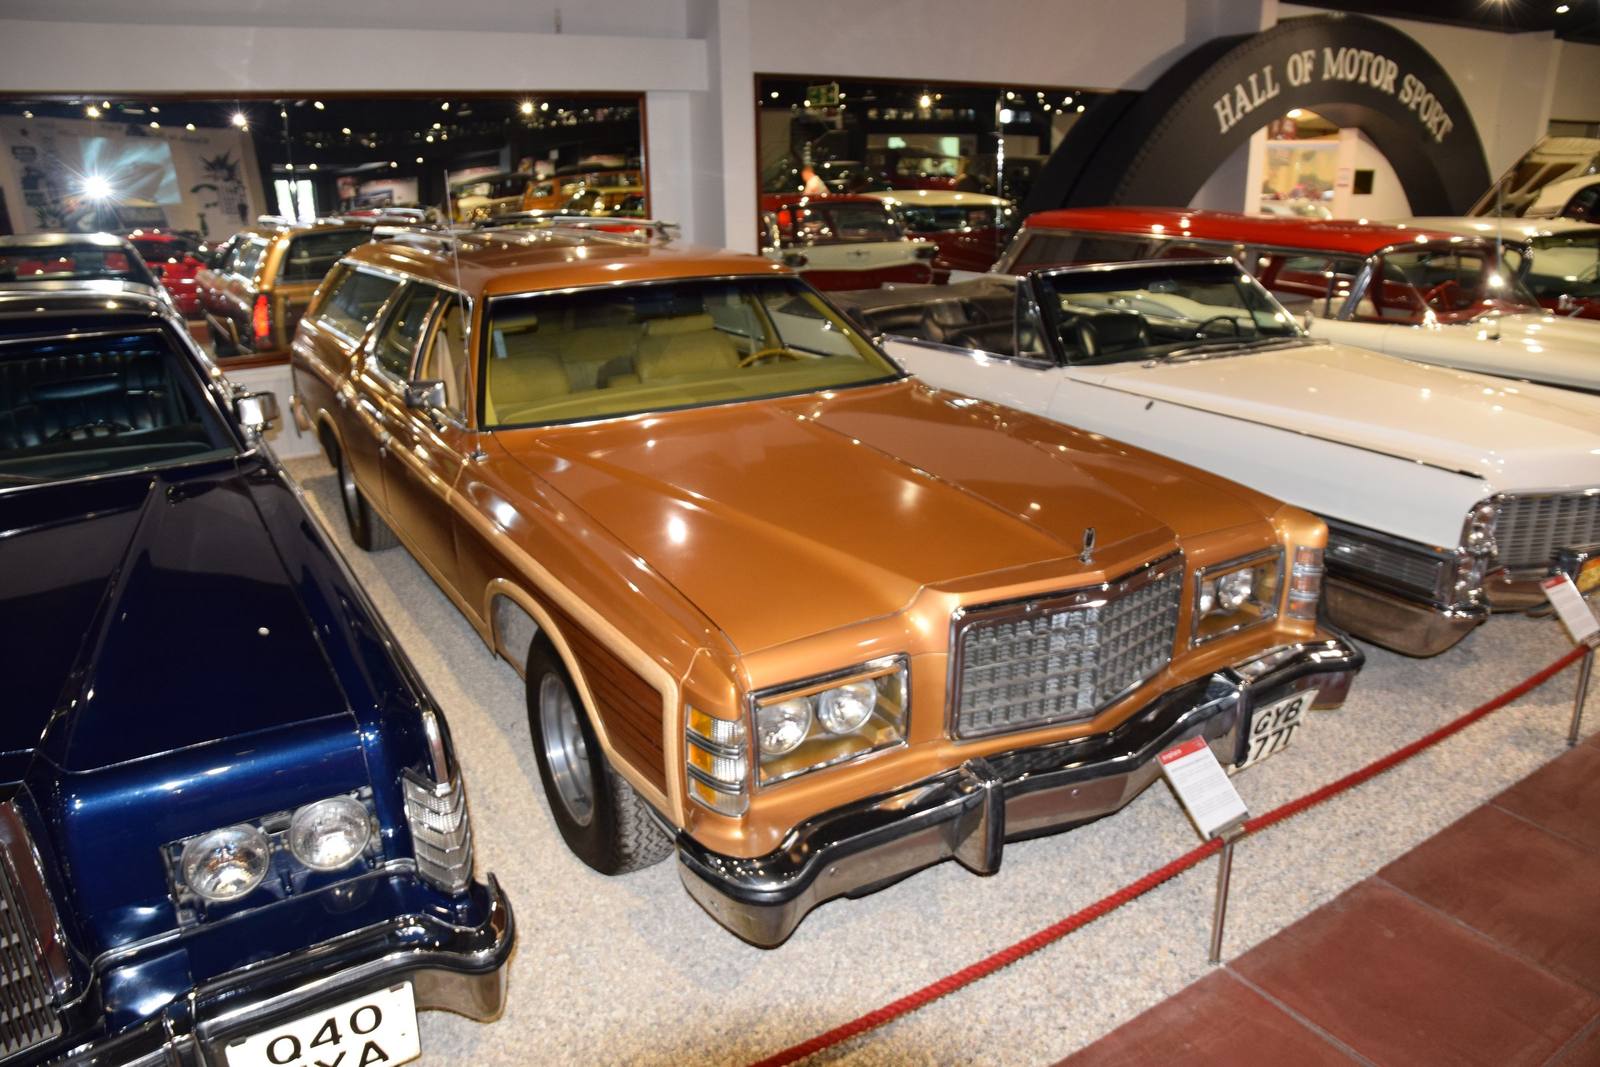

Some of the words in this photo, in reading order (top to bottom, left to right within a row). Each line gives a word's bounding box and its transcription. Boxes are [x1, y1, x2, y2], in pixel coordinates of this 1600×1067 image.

[1213, 64, 1281, 134] HALL
[1286, 49, 1316, 87] OF
[1321, 46, 1399, 95] MOTOR
[1398, 73, 1454, 144] SPORT
[1253, 697, 1303, 735] GYB
[266, 1004, 383, 1065] Q40
[299, 1040, 389, 1067] YA
